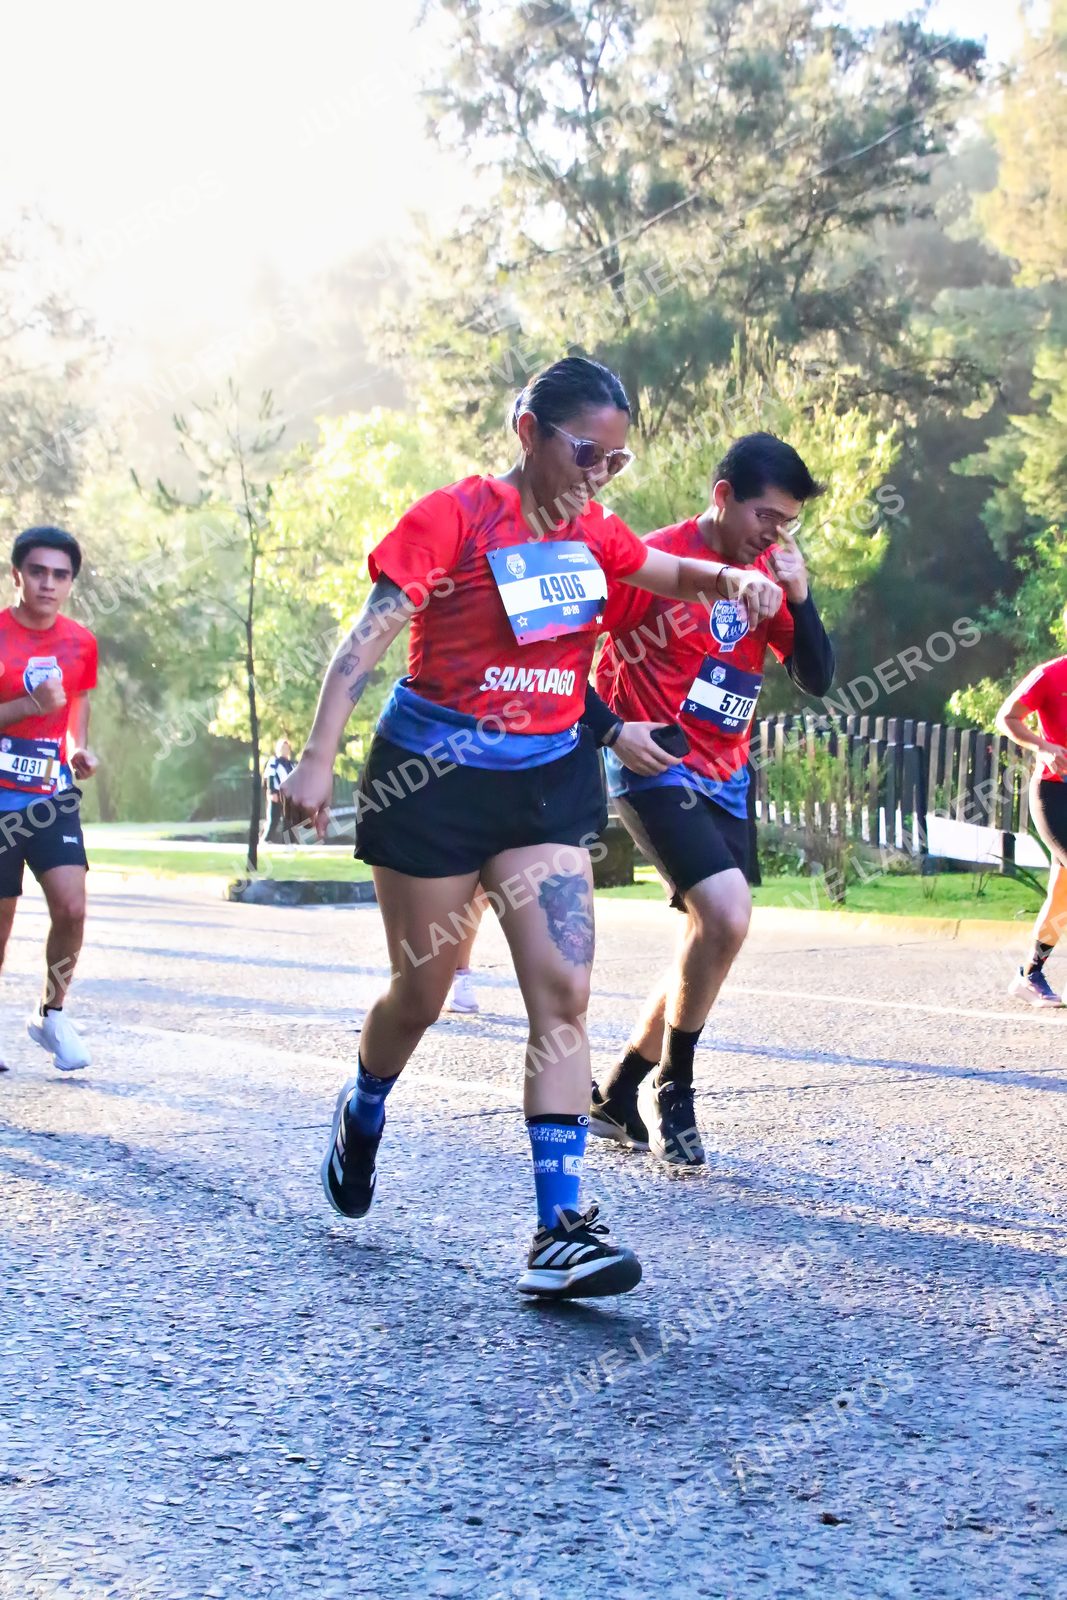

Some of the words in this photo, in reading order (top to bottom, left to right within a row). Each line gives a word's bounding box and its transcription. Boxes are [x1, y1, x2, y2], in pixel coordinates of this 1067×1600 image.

[539, 574, 586, 603] 4906
[719, 692, 754, 718] 5718
[12, 757, 42, 775] 4031
